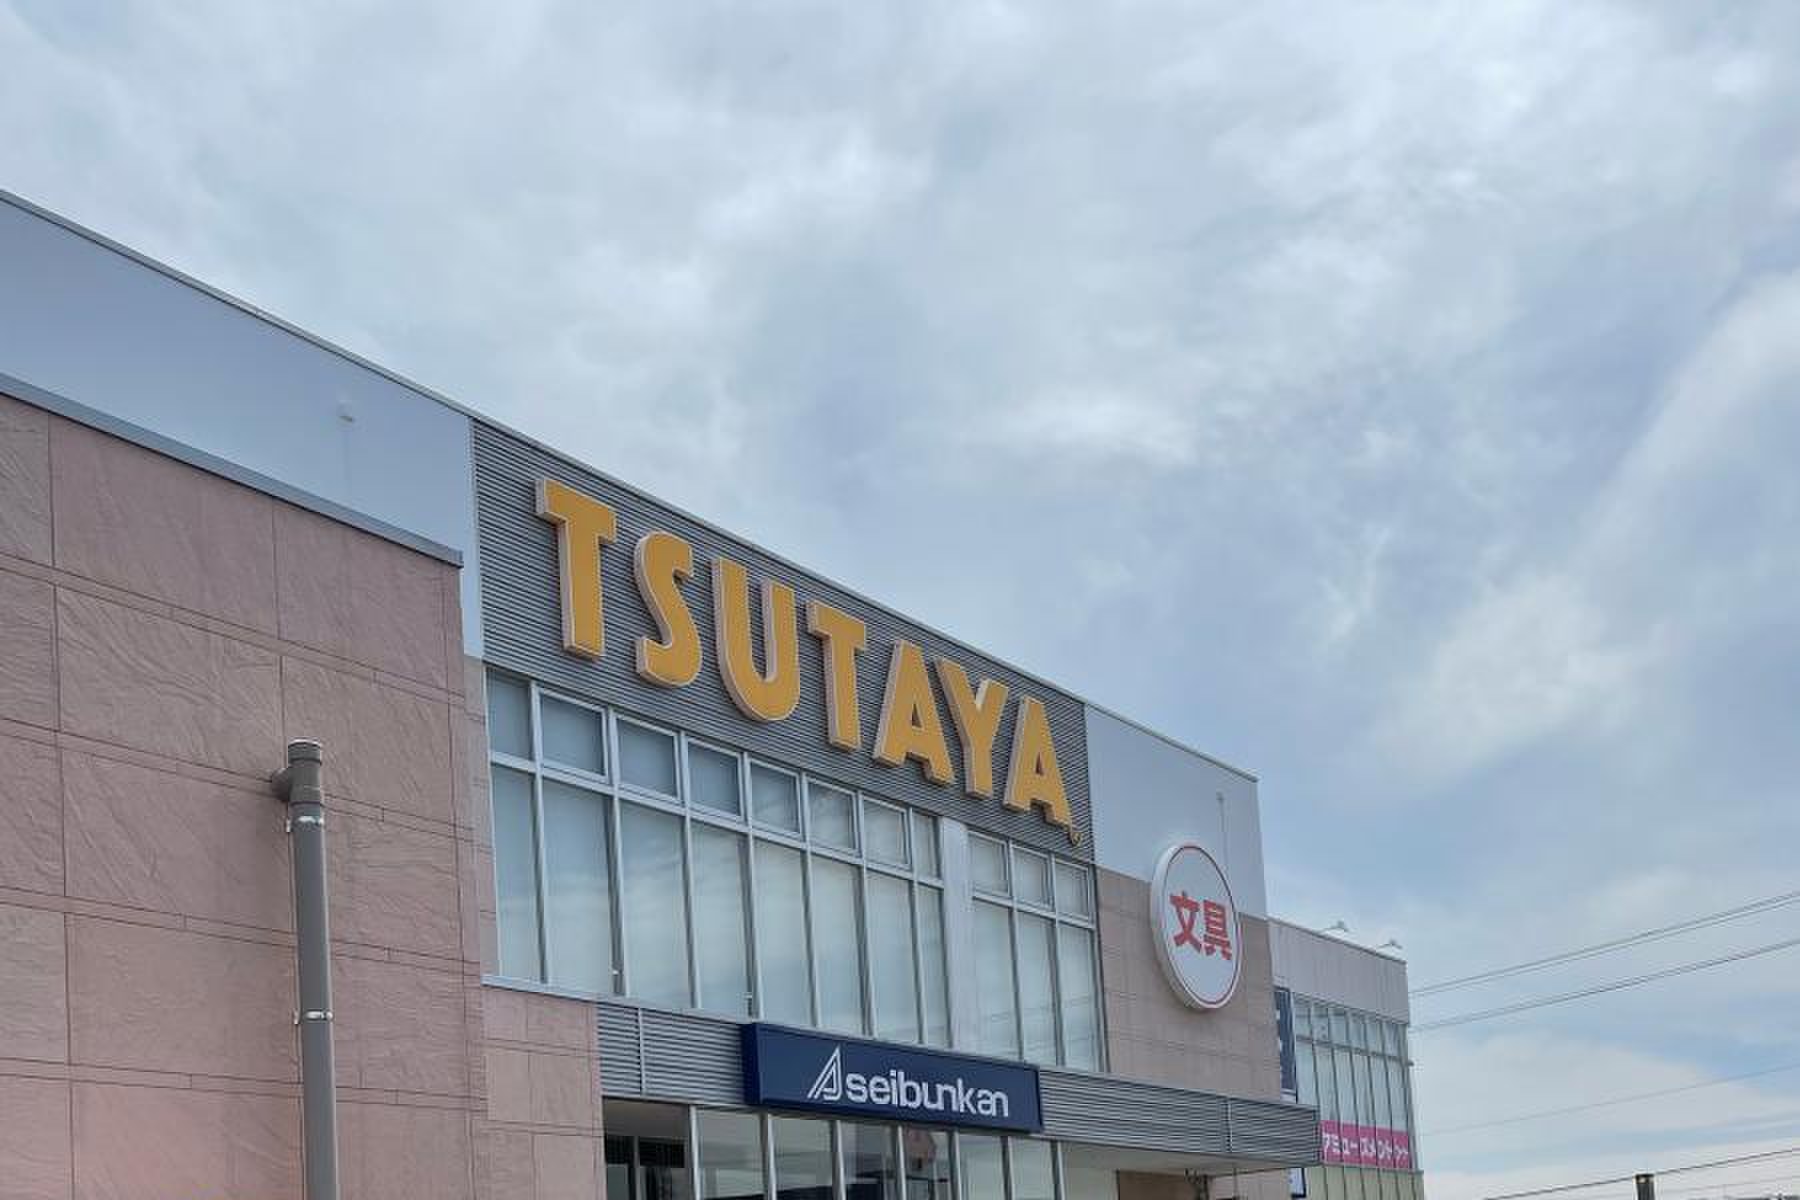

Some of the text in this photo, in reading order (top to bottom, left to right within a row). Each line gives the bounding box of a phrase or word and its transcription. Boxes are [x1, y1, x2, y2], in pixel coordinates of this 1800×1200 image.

[536, 477, 1073, 829] TSUTAYA
[1169, 889, 1232, 961] 文具
[846, 1069, 1009, 1118] seibunkan
